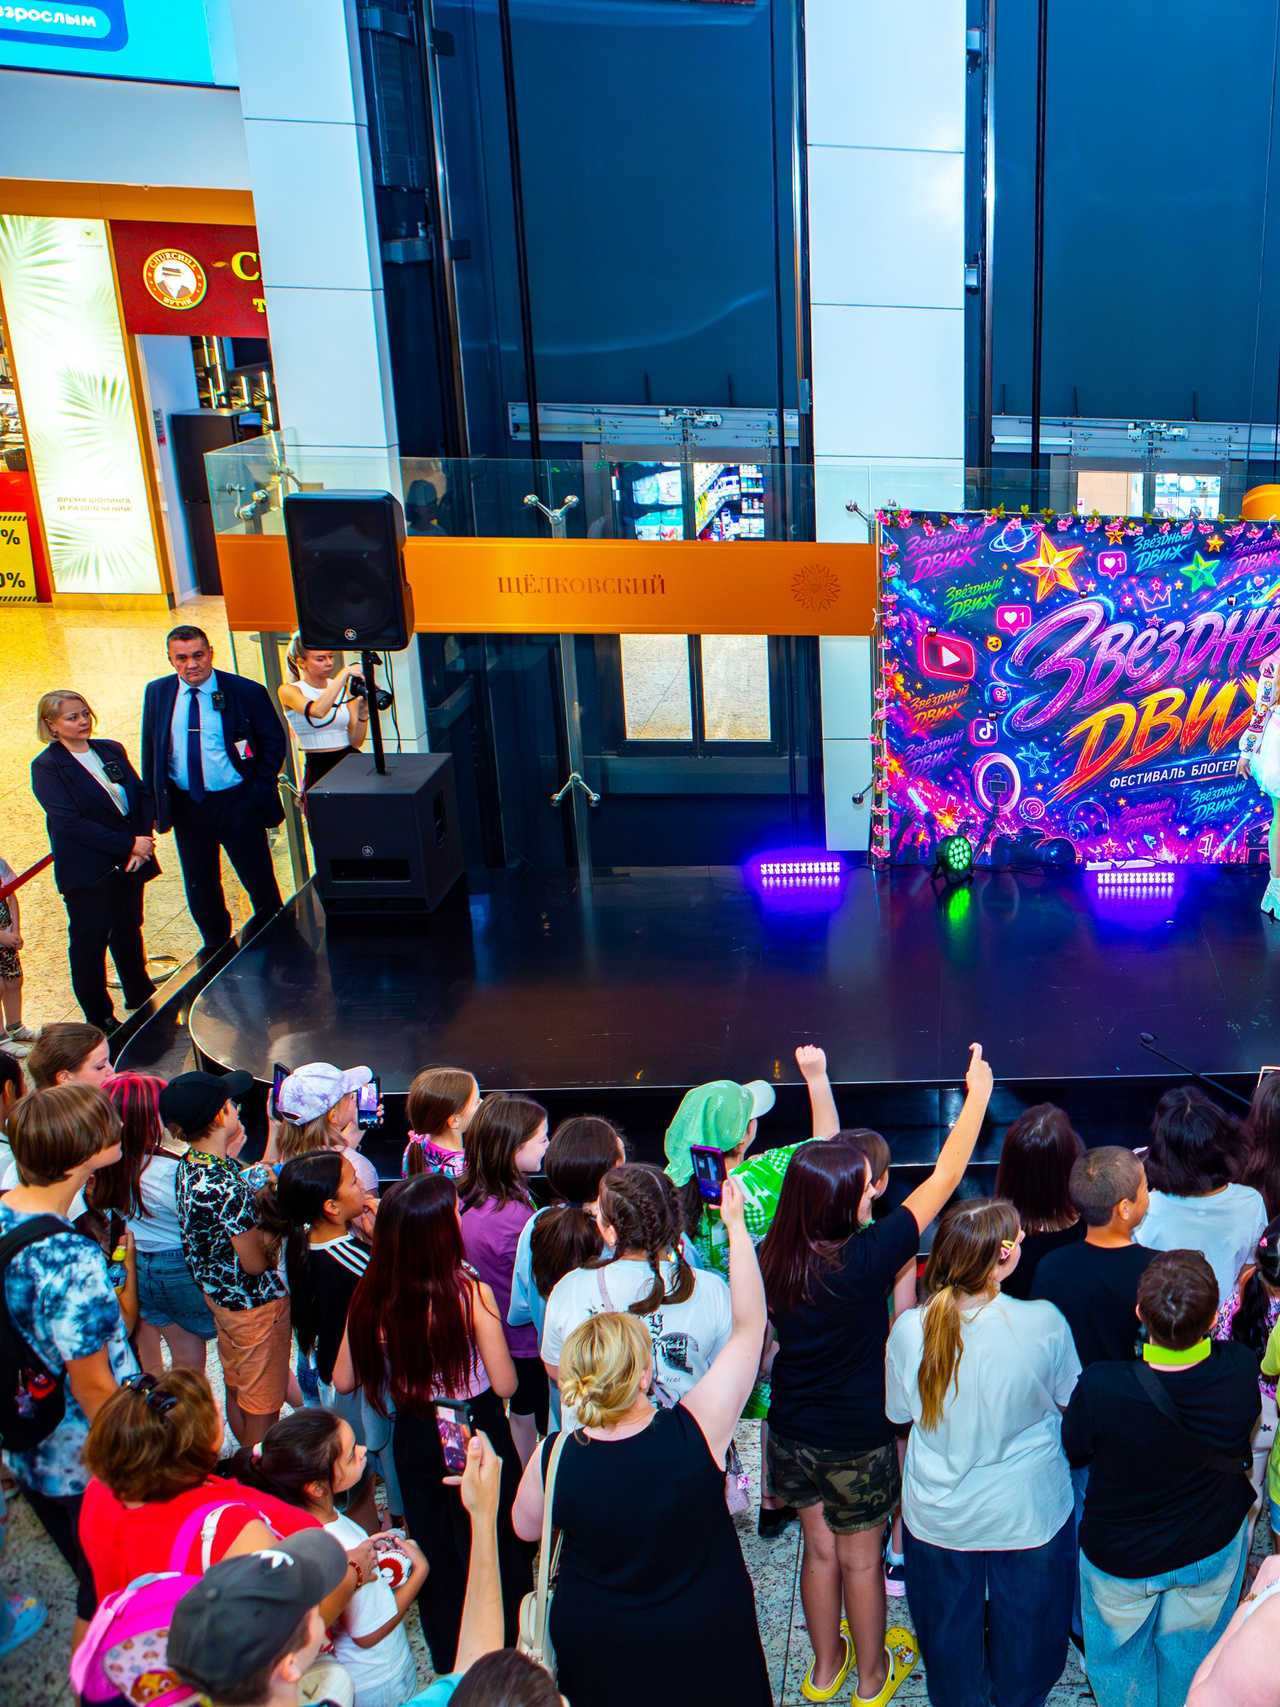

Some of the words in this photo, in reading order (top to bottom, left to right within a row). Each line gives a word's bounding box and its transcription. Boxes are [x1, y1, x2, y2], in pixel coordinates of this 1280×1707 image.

[148, 251, 198, 271] CHURCHILL
[497, 574, 667, 597] ЩЁЛКОВСКИЙ
[1109, 766, 1186, 789] ФЕСТИВАЛЬ
[1190, 759, 1238, 777] БЛОГЕР
